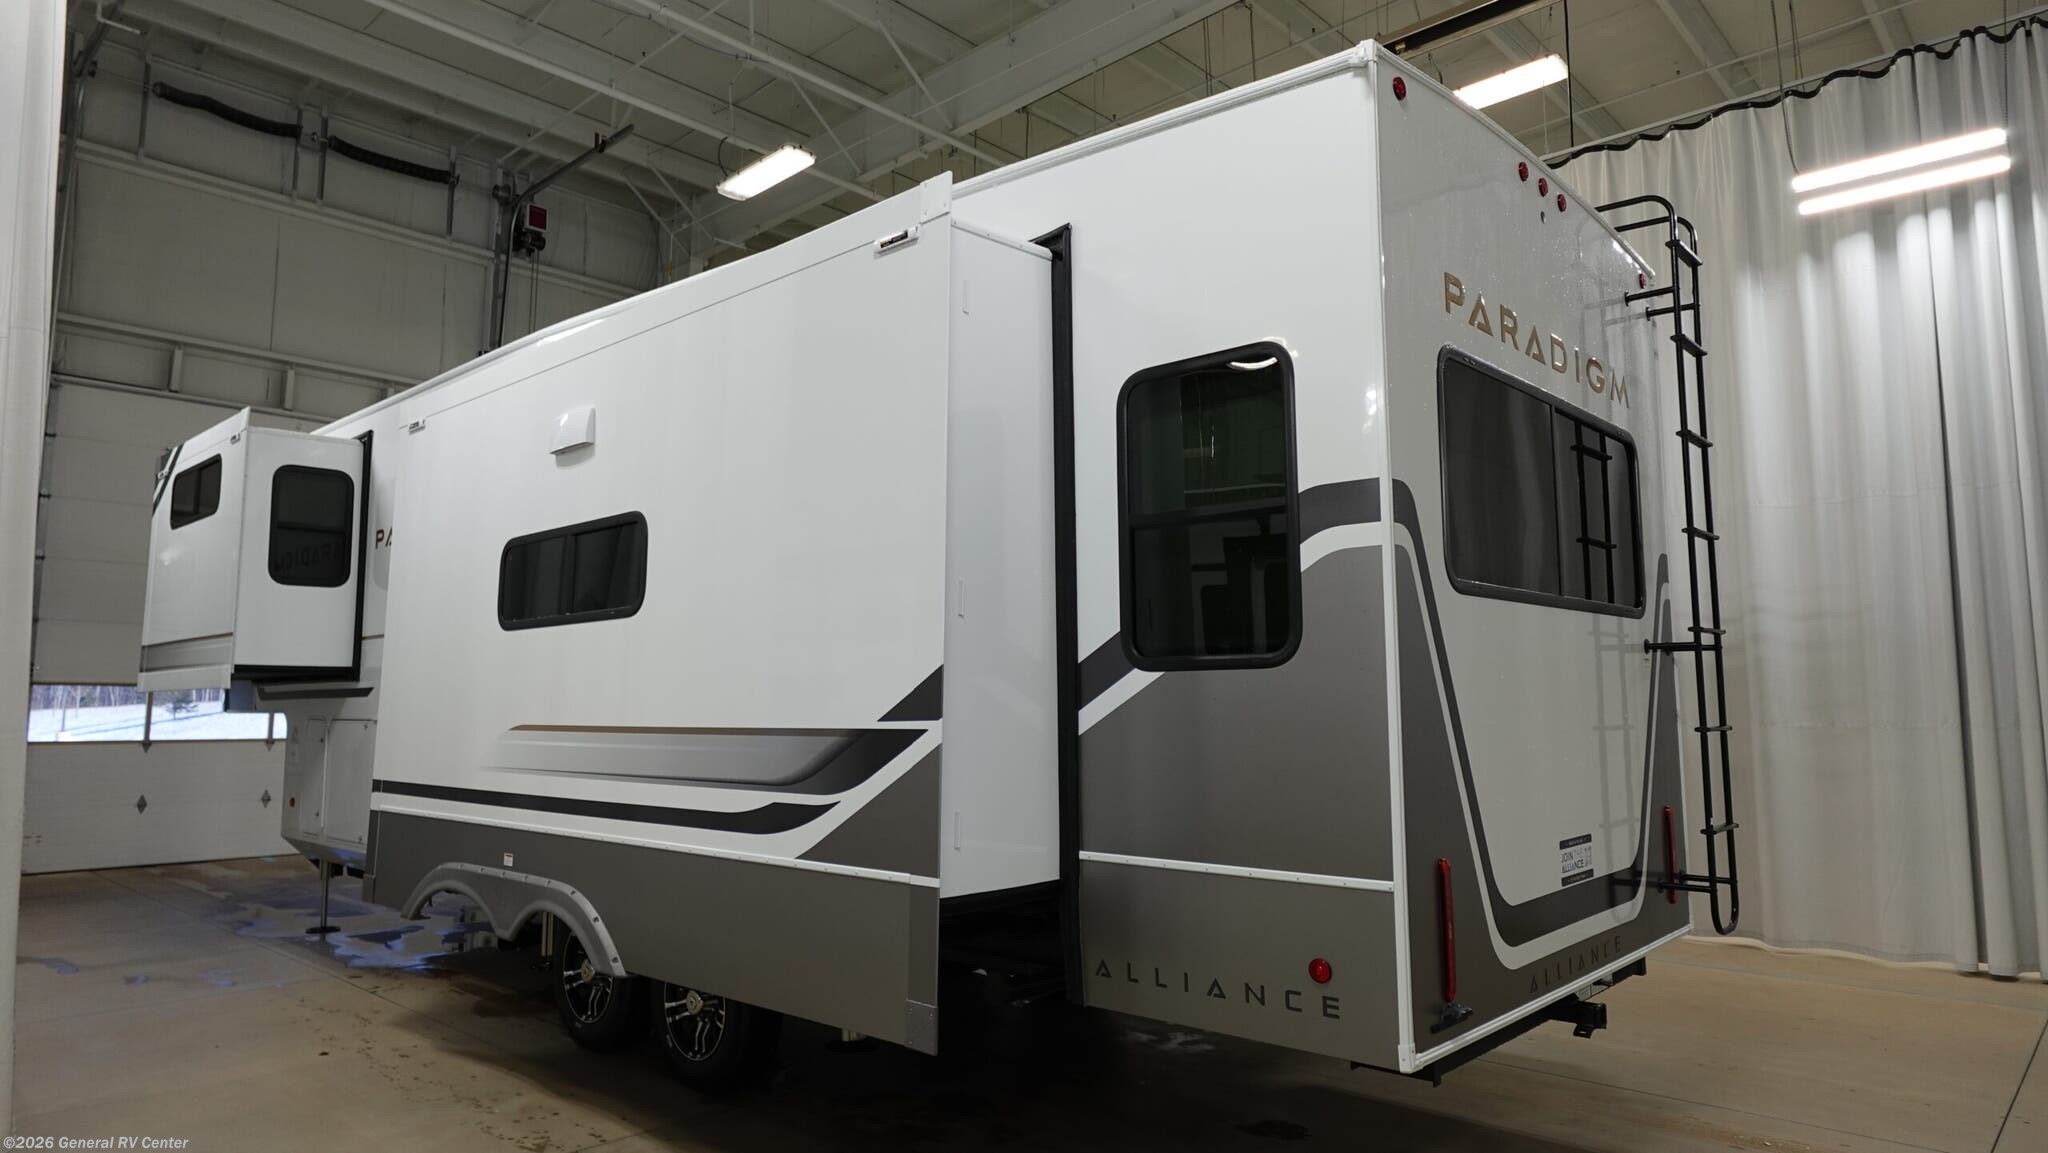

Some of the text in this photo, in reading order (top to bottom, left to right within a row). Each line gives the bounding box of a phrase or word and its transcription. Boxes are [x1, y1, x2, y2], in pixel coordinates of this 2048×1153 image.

[1443, 271, 1630, 409] PARADIGM
[1095, 959, 1341, 1019] ALLIANCE
[1529, 935, 1621, 994] ALLIANCE
